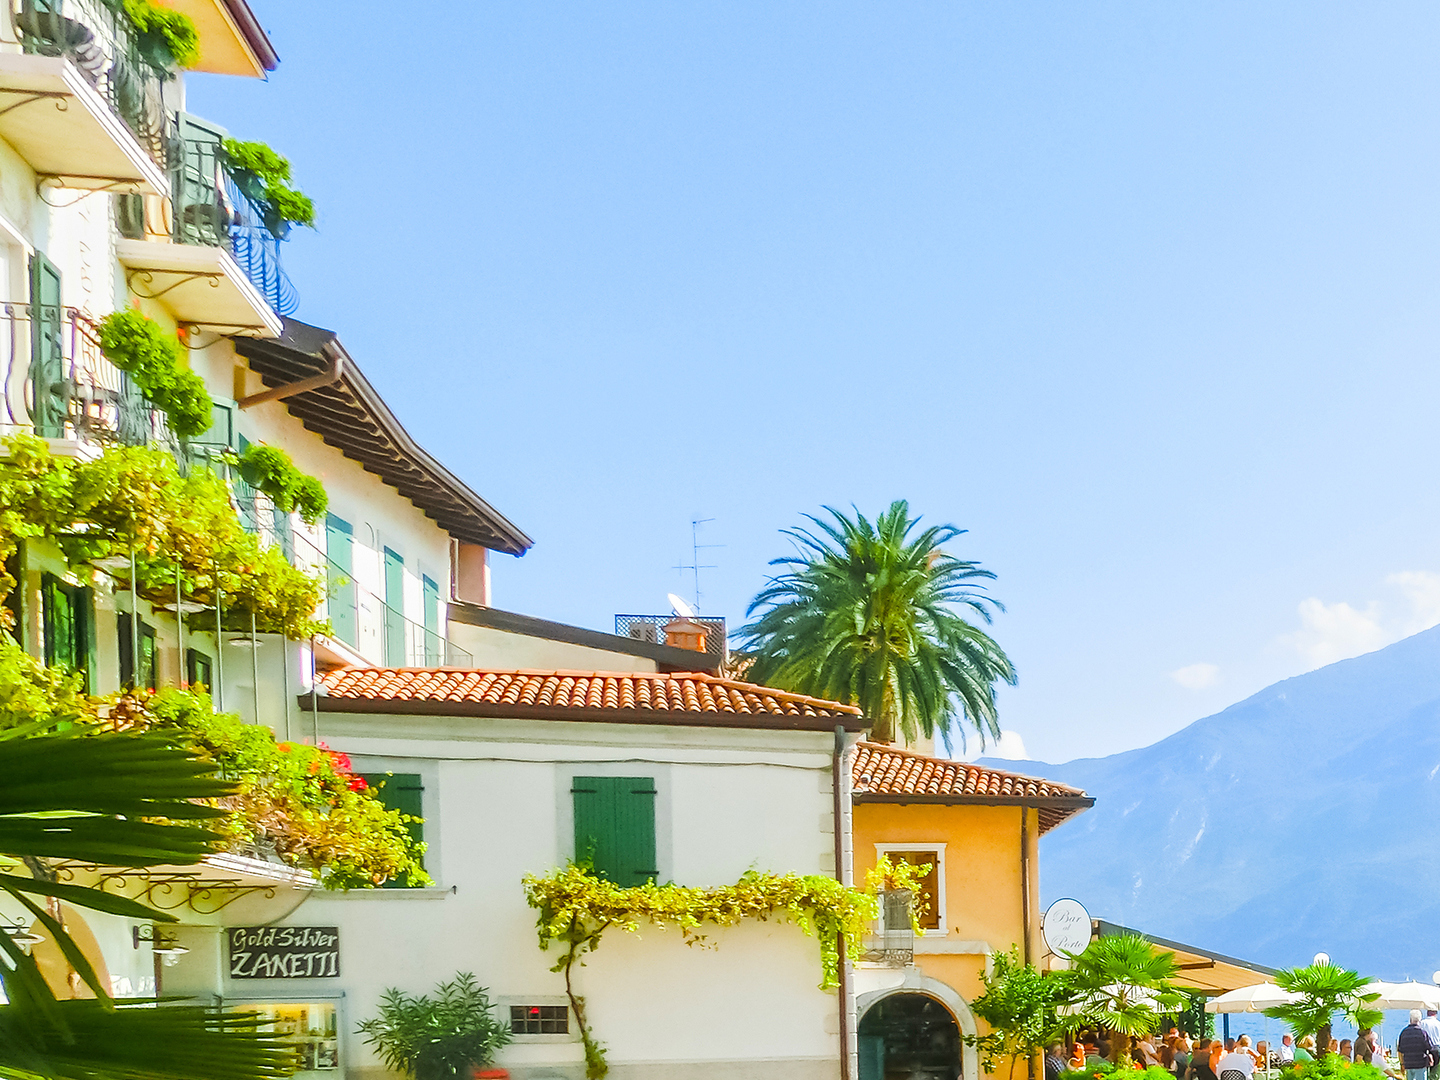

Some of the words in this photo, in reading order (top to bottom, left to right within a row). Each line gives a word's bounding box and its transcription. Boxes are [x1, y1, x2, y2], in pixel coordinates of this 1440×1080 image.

[1053, 910, 1082, 923] Bar
[233, 928, 337, 953] Gold-Silver
[1051, 935, 1083, 948] Porto
[231, 952, 337, 977] ZANETTI
